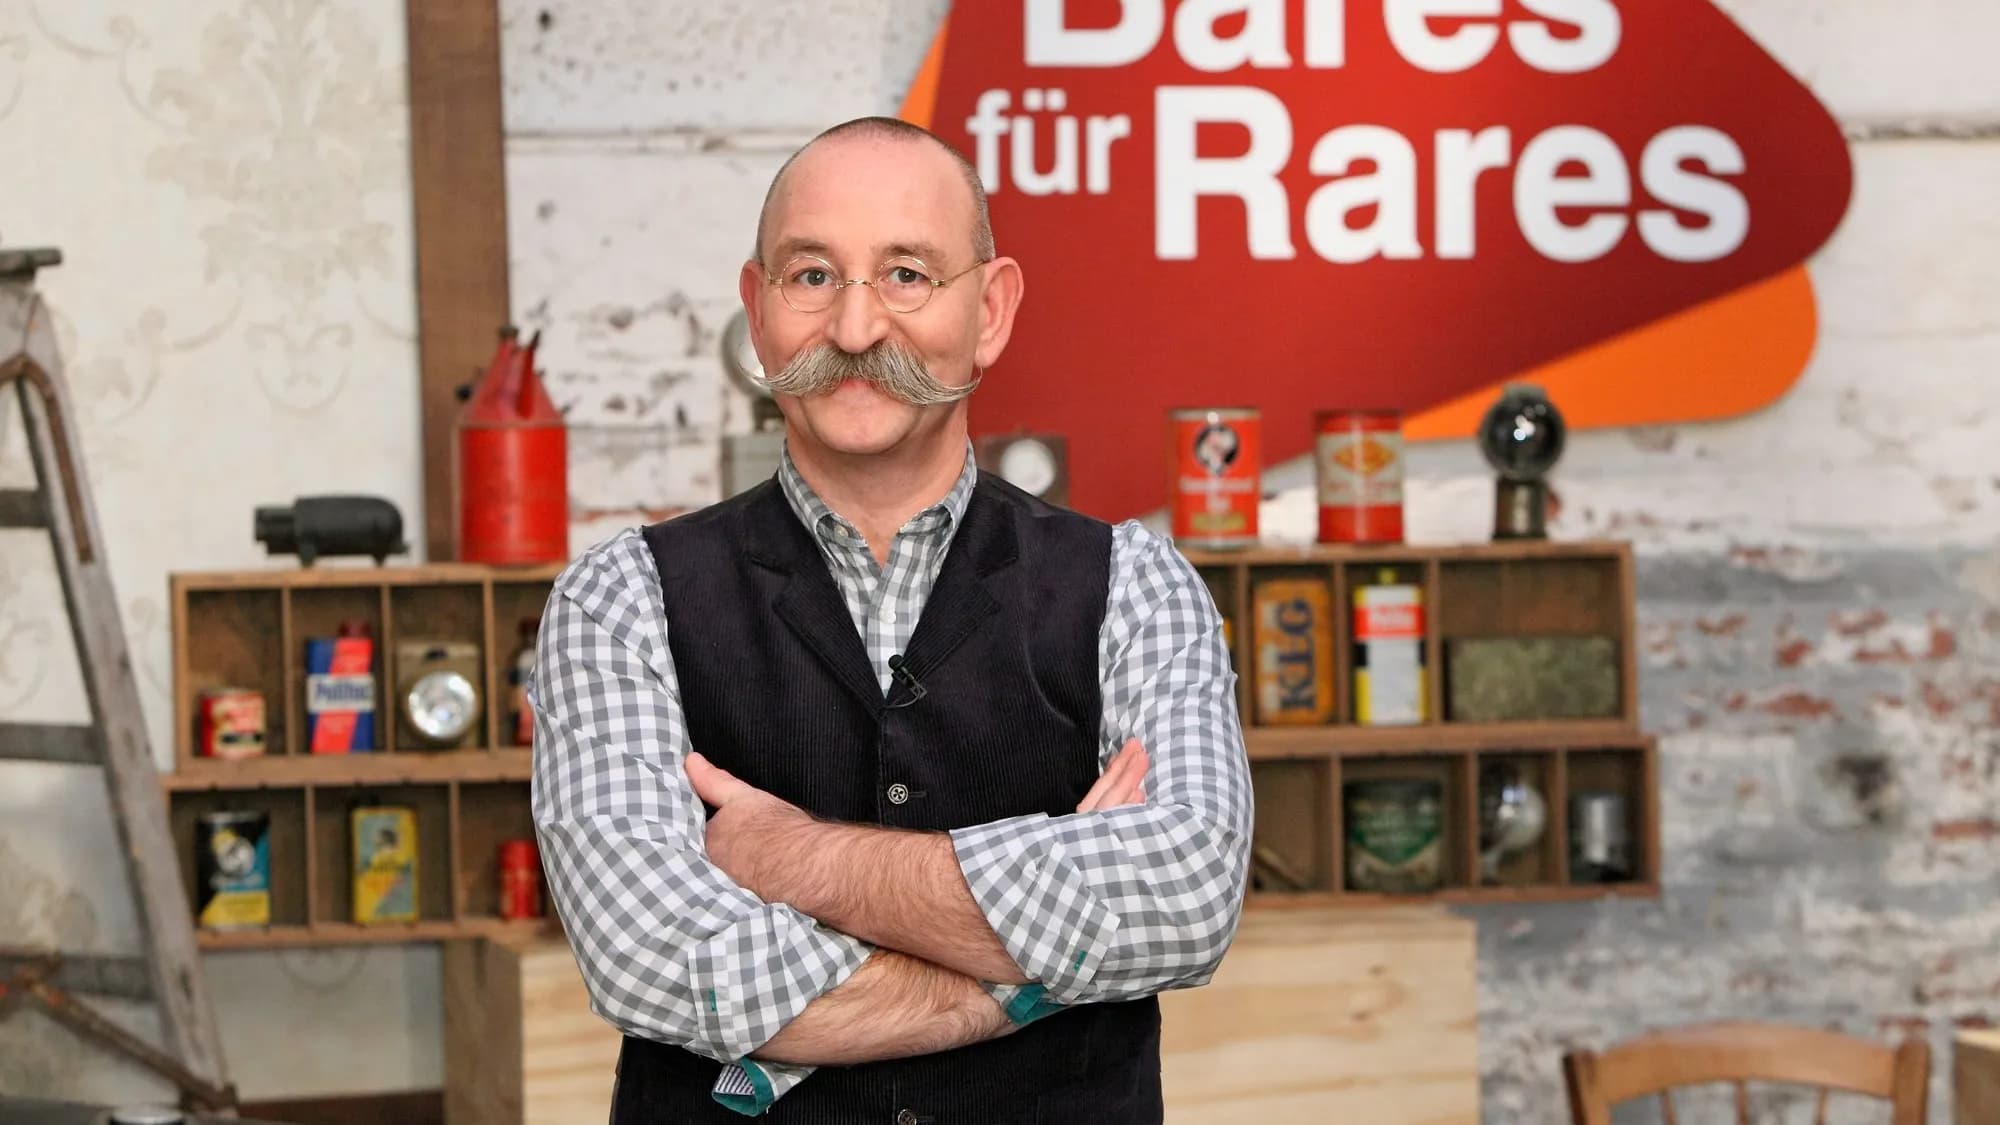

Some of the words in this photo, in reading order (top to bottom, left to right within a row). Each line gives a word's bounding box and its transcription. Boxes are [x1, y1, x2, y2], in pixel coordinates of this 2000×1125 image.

[965, 87, 1131, 195] für
[1154, 85, 1750, 263] Rares
[1275, 596, 1316, 710] KLG
